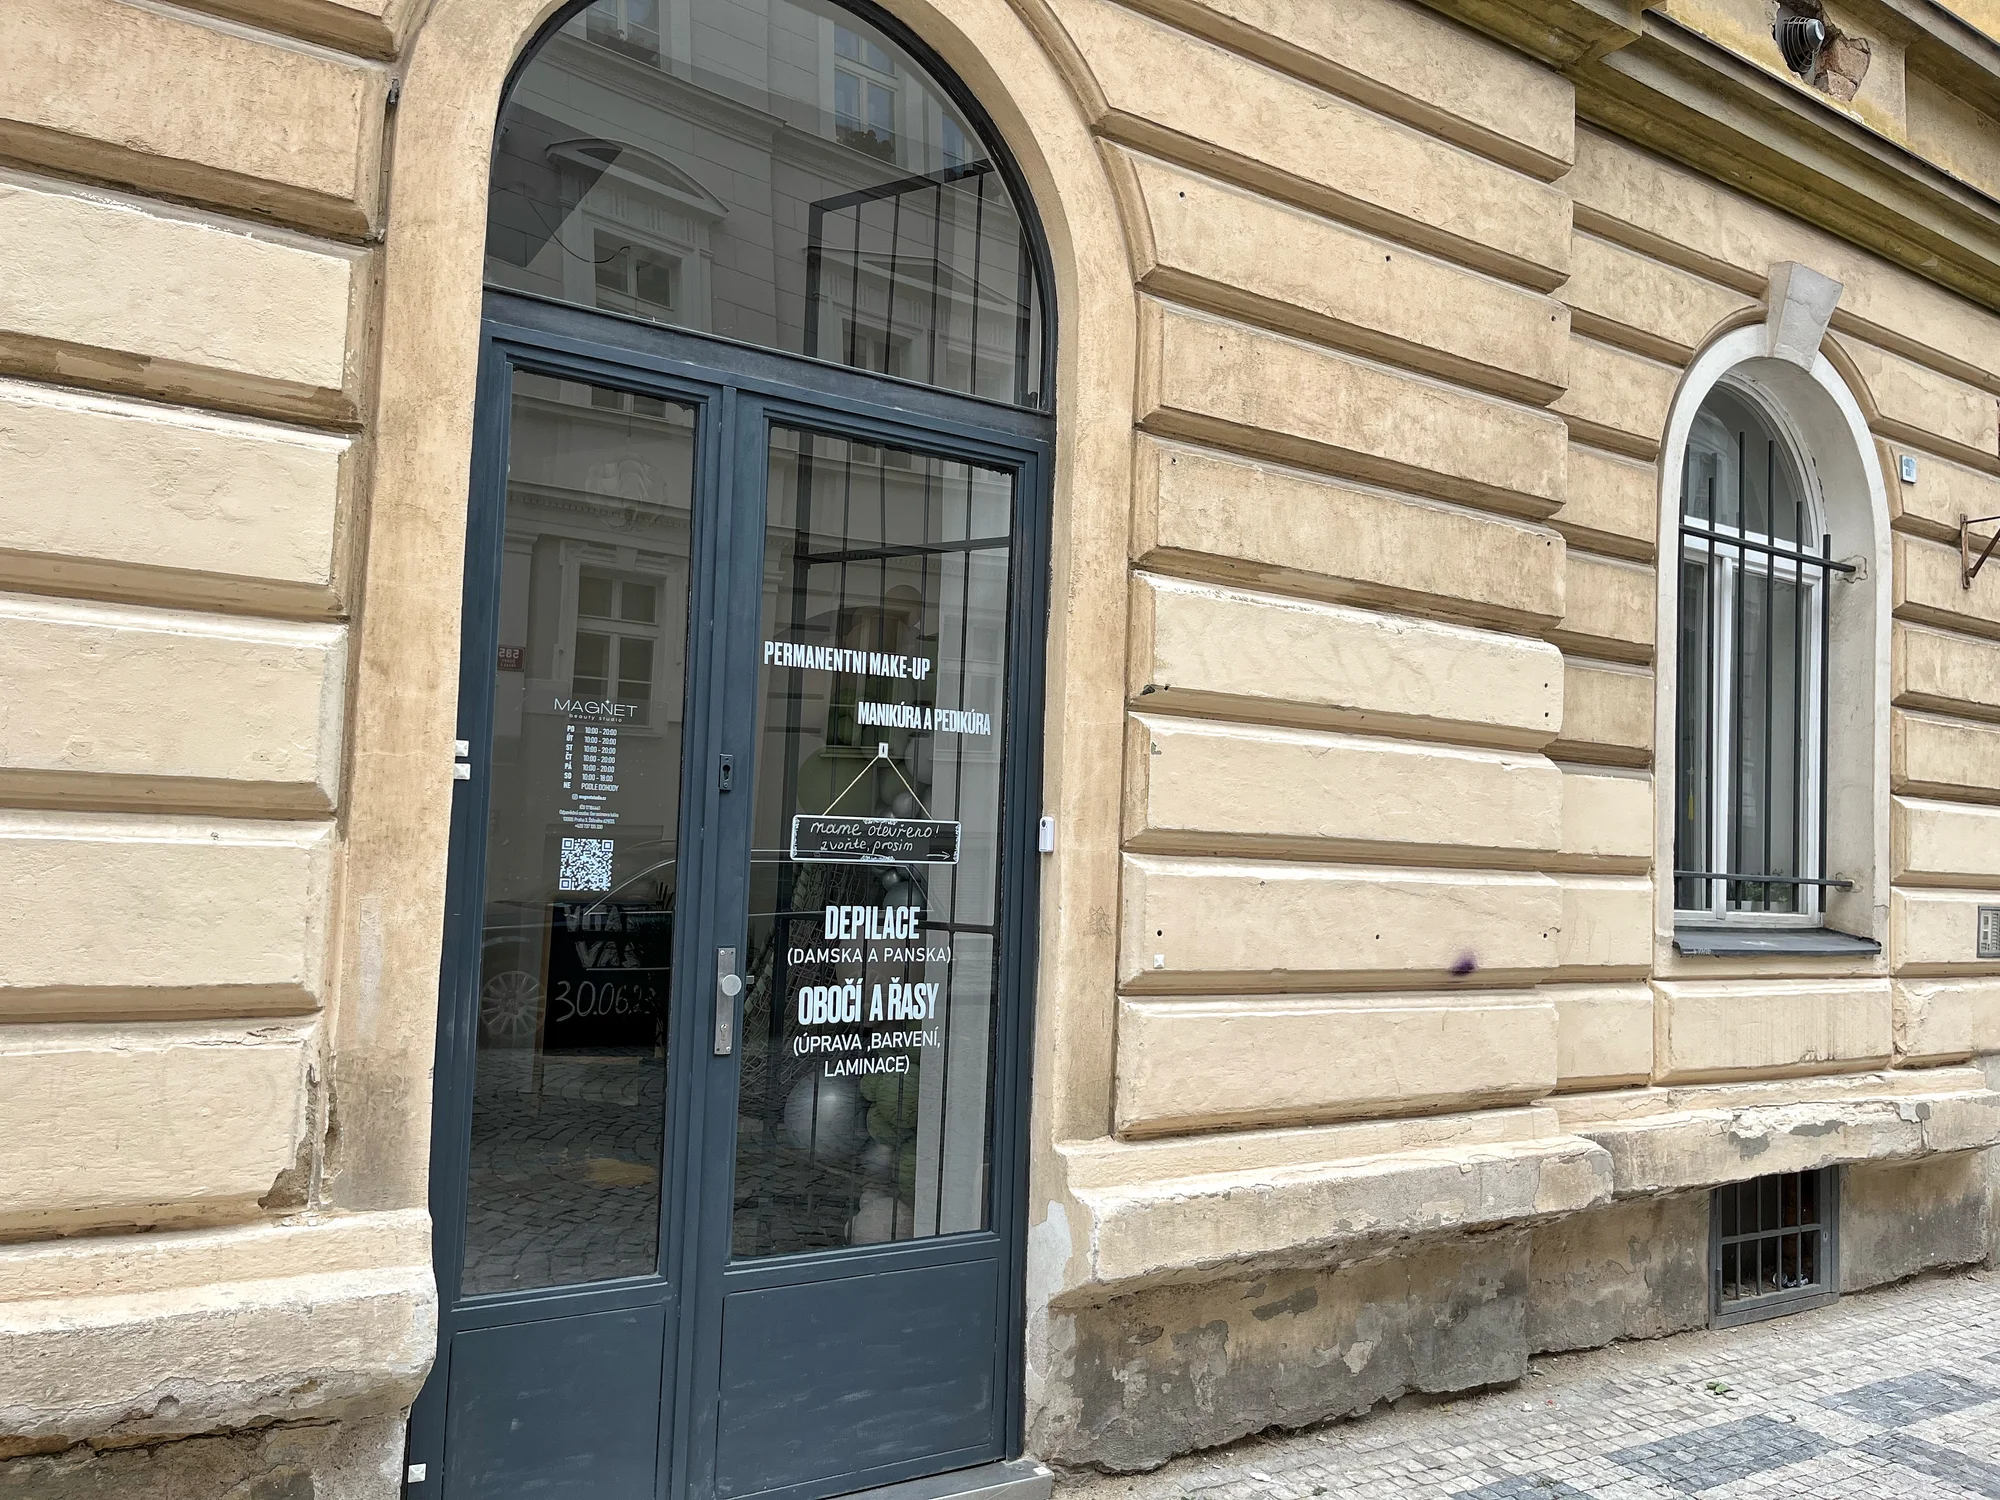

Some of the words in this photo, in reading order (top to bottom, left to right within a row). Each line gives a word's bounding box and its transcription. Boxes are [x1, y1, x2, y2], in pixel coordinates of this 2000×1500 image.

[764, 640, 866, 675] PERMANENTNI
[869, 651, 931, 681] MAKE-UP
[554, 697, 638, 717] MAGNET
[568, 713, 596, 721] beauty
[857, 700, 922, 730] MANIKÚRA
[923, 709, 932, 730] A
[934, 708, 991, 736] PEDIKÚRA
[566, 725, 575, 733] PO
[566, 733, 574, 742] ÚT
[564, 762, 572, 770] PÁ
[565, 752, 573, 760] ČT
[563, 772, 572, 780] SO
[563, 781, 572, 789] NE
[825, 905, 920, 940] DEPILACE
[787, 947, 863, 966] (DAMSKA
[868, 948, 878, 962] A
[884, 946, 951, 964] PANSKA)
[798, 978, 863, 1026] OBOČÍ
[869, 984, 883, 1022] A
[888, 976, 939, 1020] ŘASY
[793, 1029, 862, 1056] (ÚPRAVA
[824, 1055, 910, 1077] LAMINACE)
